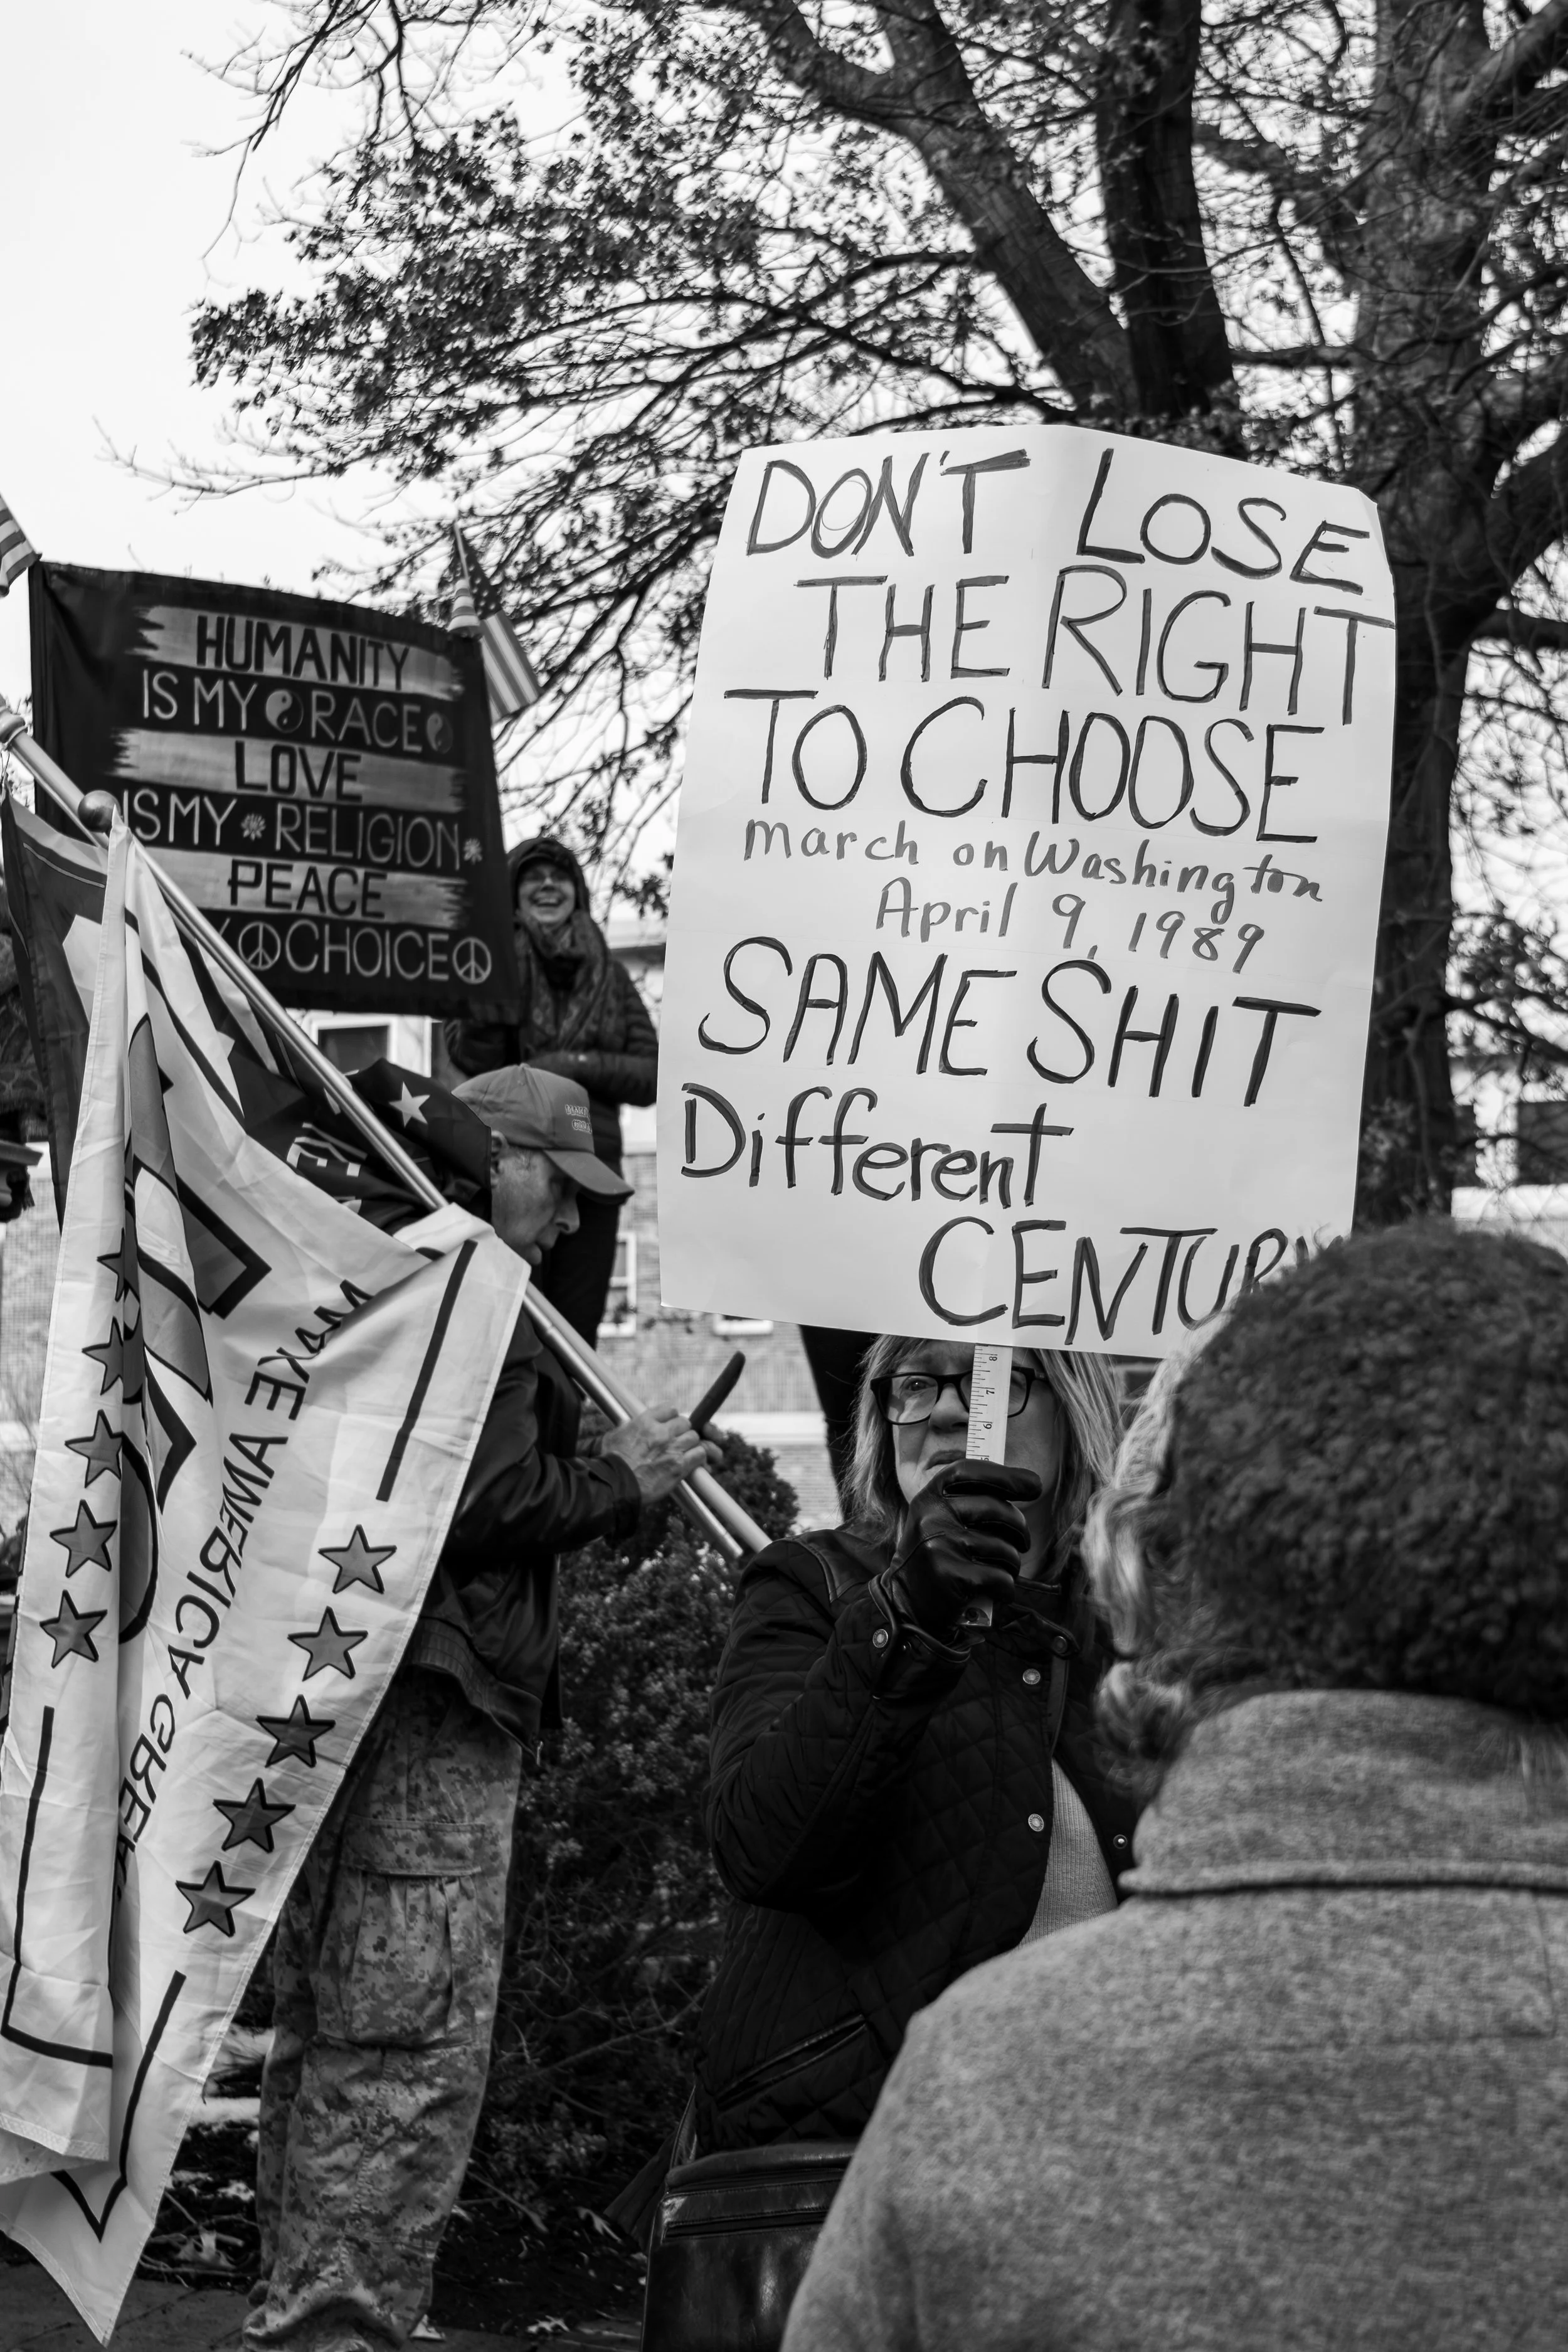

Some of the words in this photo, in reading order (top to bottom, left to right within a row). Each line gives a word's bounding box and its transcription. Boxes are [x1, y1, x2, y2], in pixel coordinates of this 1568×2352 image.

[746, 449, 1031, 559] DON'T
[1076, 448, 1370, 595] LOSE
[196, 614, 410, 691] HUMANITY
[793, 575, 1010, 682] THE
[1042, 564, 1396, 726] RIGHT
[143, 670, 179, 719] IS
[194, 677, 258, 731] MY
[312, 690, 423, 752] RACE
[235, 741, 362, 802] LOVE
[724, 689, 867, 810] TO
[901, 696, 1325, 842] CHOOSE
[169, 793, 237, 845] MY
[276, 803, 460, 870] RELIGION
[953, 840, 1008, 871] on
[1024, 831, 1322, 925] Washington
[228, 859, 388, 918] PEACE
[876, 877, 1017, 943] April
[1052, 894, 1098, 960] 9,
[1128, 911, 1264, 973] 1989
[285, 919, 449, 981] CHOICE
[698, 936, 1017, 1076] SAME
[1027, 960, 1322, 1107] SHIT
[681, 1083, 1074, 1209] Different
[919, 1216, 1343, 1345] CENTUR
